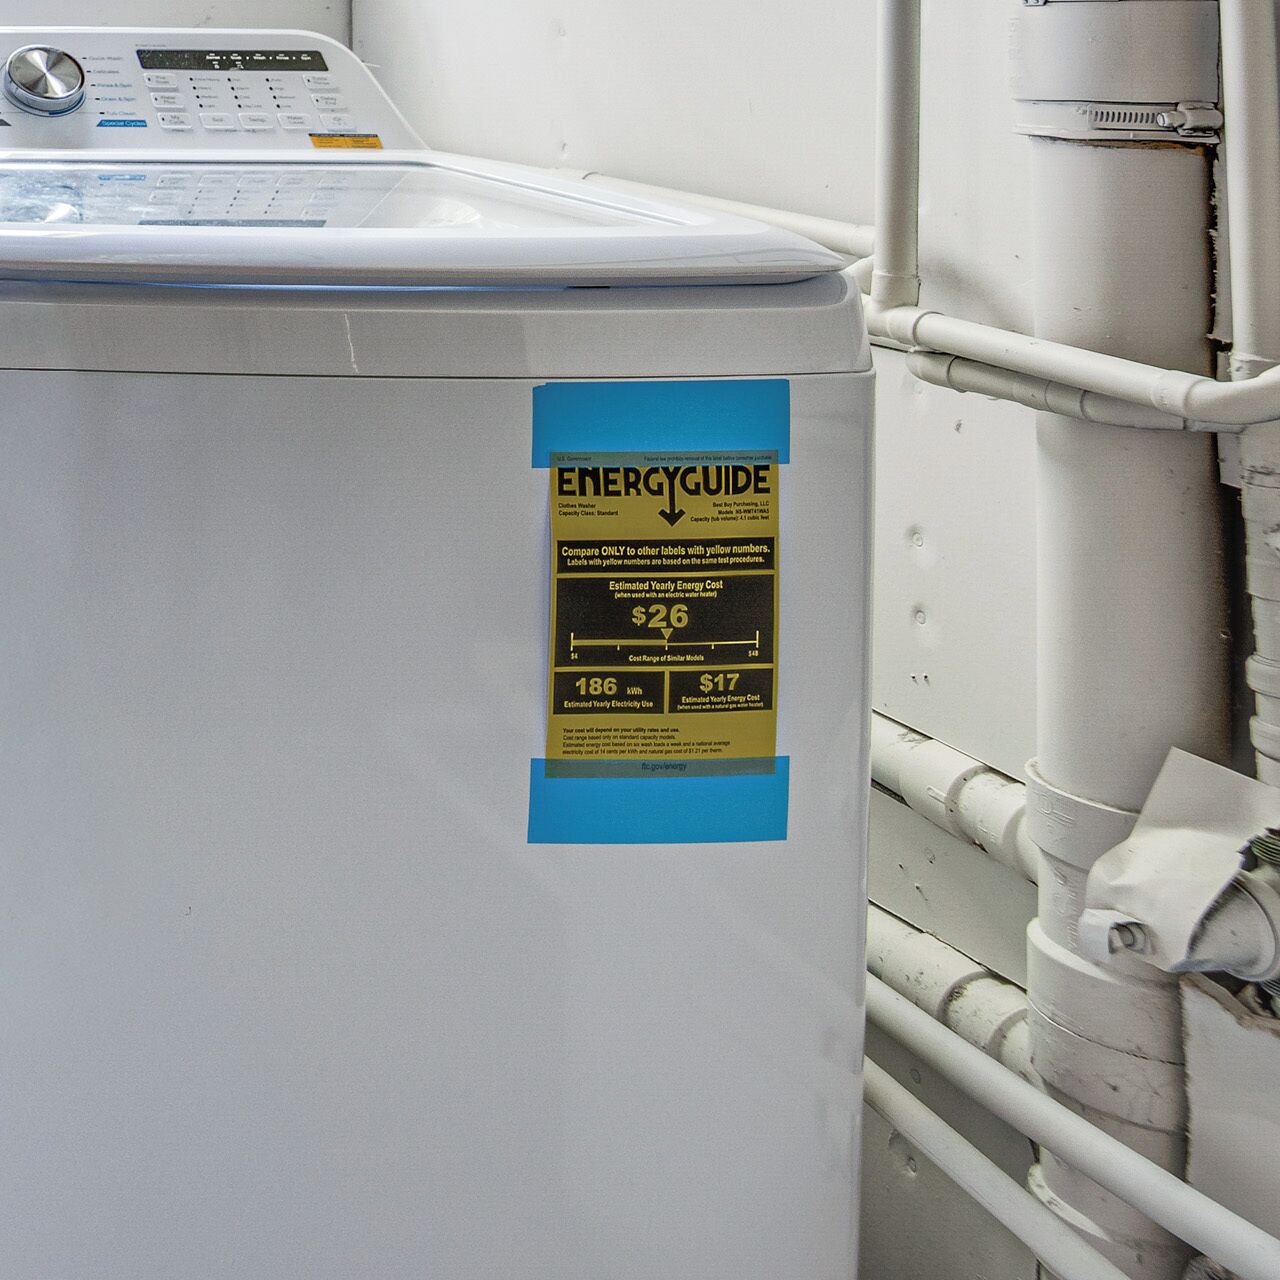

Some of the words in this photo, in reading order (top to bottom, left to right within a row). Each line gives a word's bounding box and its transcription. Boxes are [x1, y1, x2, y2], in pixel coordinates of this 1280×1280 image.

[558, 465, 770, 496] ENERGYGUIDE
[562, 546, 599, 557] Compare
[601, 546, 625, 555] ONLY
[627, 546, 635, 555] to
[638, 546, 660, 554] other
[661, 545, 685, 554] labels
[687, 545, 704, 554] with
[705, 545, 731, 555] yellow
[733, 545, 770, 553] numbers.
[603, 558, 622, 566] yellow
[609, 581, 649, 590] Estimated
[651, 581, 675, 591] Yearly
[677, 580, 704, 591] Energy
[706, 580, 723, 589] Cost
[632, 604, 689, 628] $26
[643, 655, 659, 663] Range
[576, 677, 617, 695] 186
[627, 687, 642, 695] kWh
[700, 673, 739, 693] $17
[710, 695, 727, 703] Yearly
[728, 695, 746, 703] Energy
[593, 701, 610, 709] Yearly
[612, 701, 640, 709] Electricity
[641, 762, 687, 771] ftc.gov/energy
